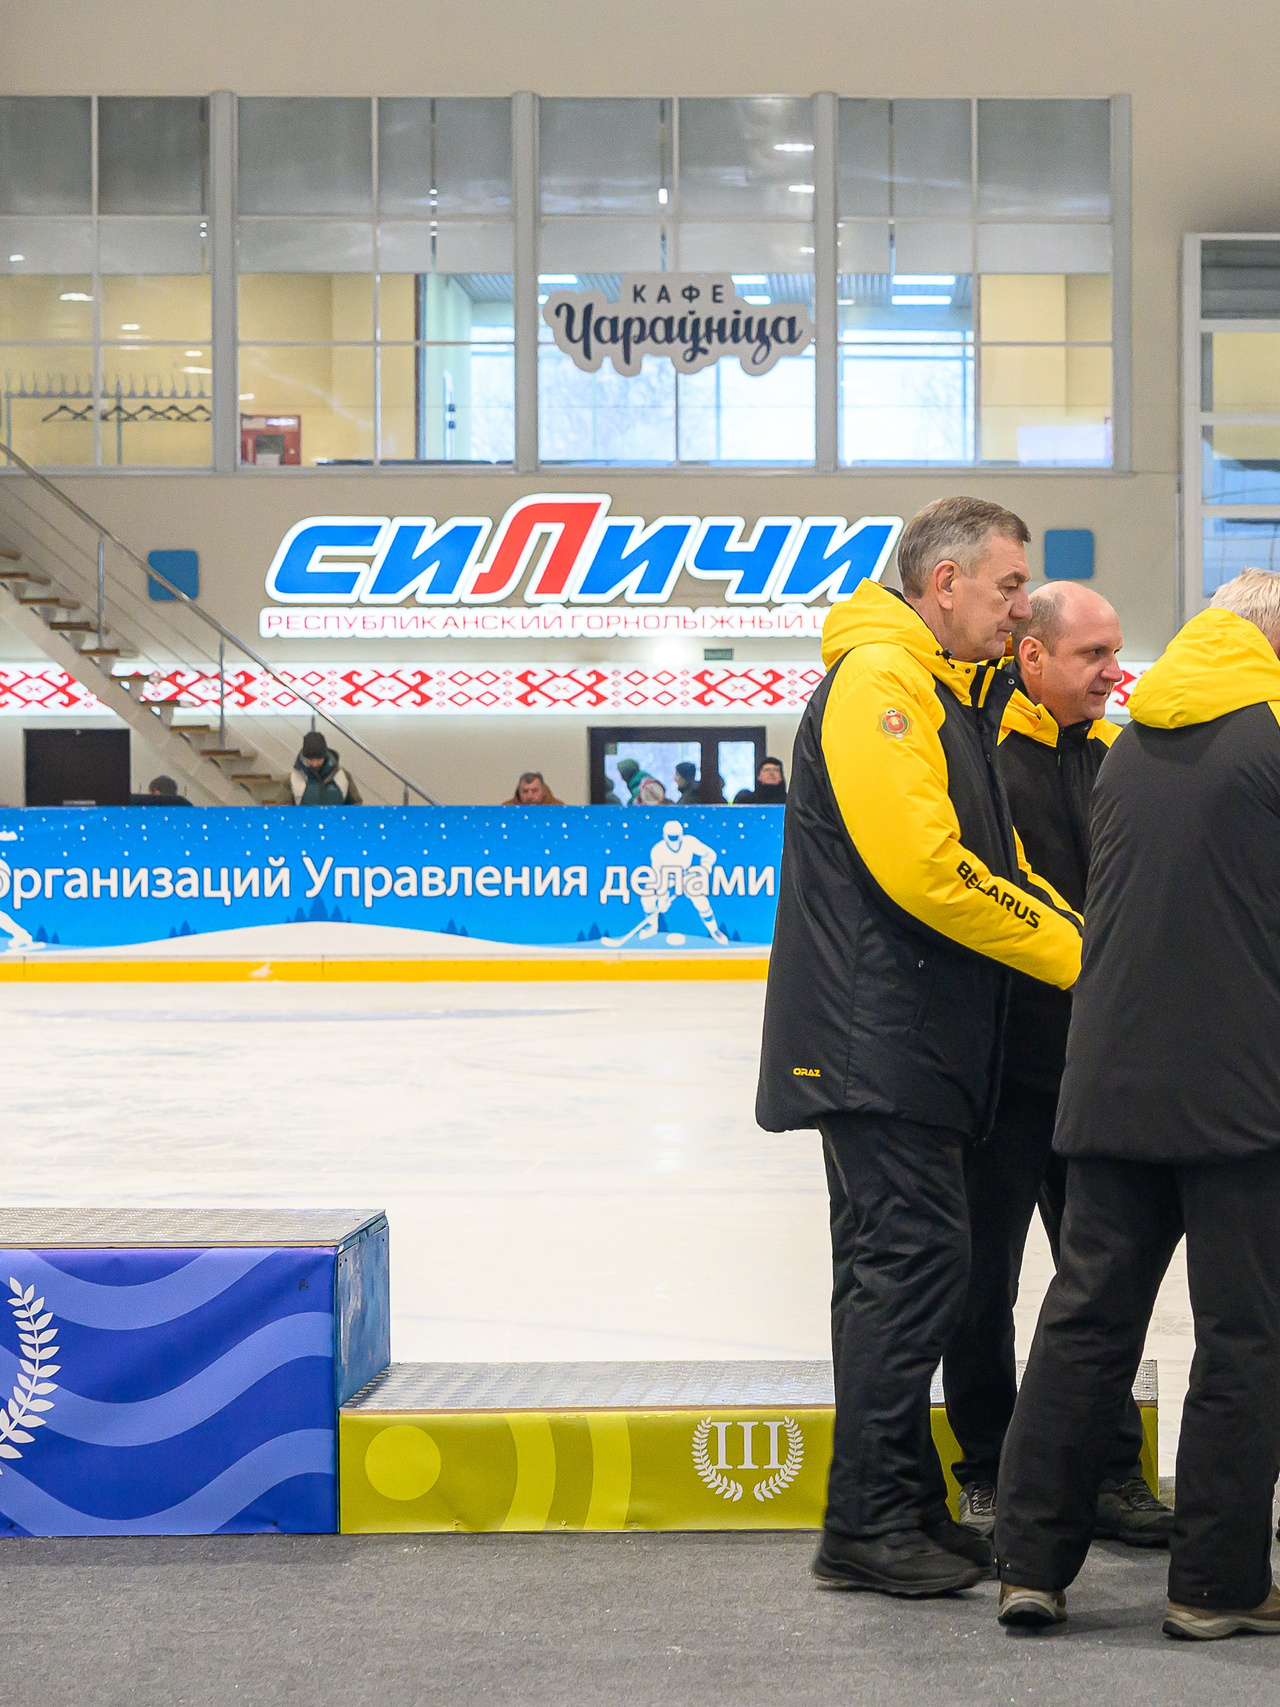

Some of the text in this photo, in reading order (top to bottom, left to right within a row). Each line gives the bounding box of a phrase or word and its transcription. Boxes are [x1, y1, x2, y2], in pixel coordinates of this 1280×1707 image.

[632, 284, 725, 304] КАФЕ
[554, 302, 803, 366] Чараўніца
[266, 611, 563, 631] РЕСПУБЛИКАНСКИЙ
[571, 611, 803, 631] ГОРНОЛЫЖНЫЙ
[303, 856, 588, 908] Управления
[600, 865, 775, 905] делами
[956, 860, 1041, 929] BELARUS
[792, 1067, 821, 1077] ORAZ
[710, 1421, 785, 1470] III
